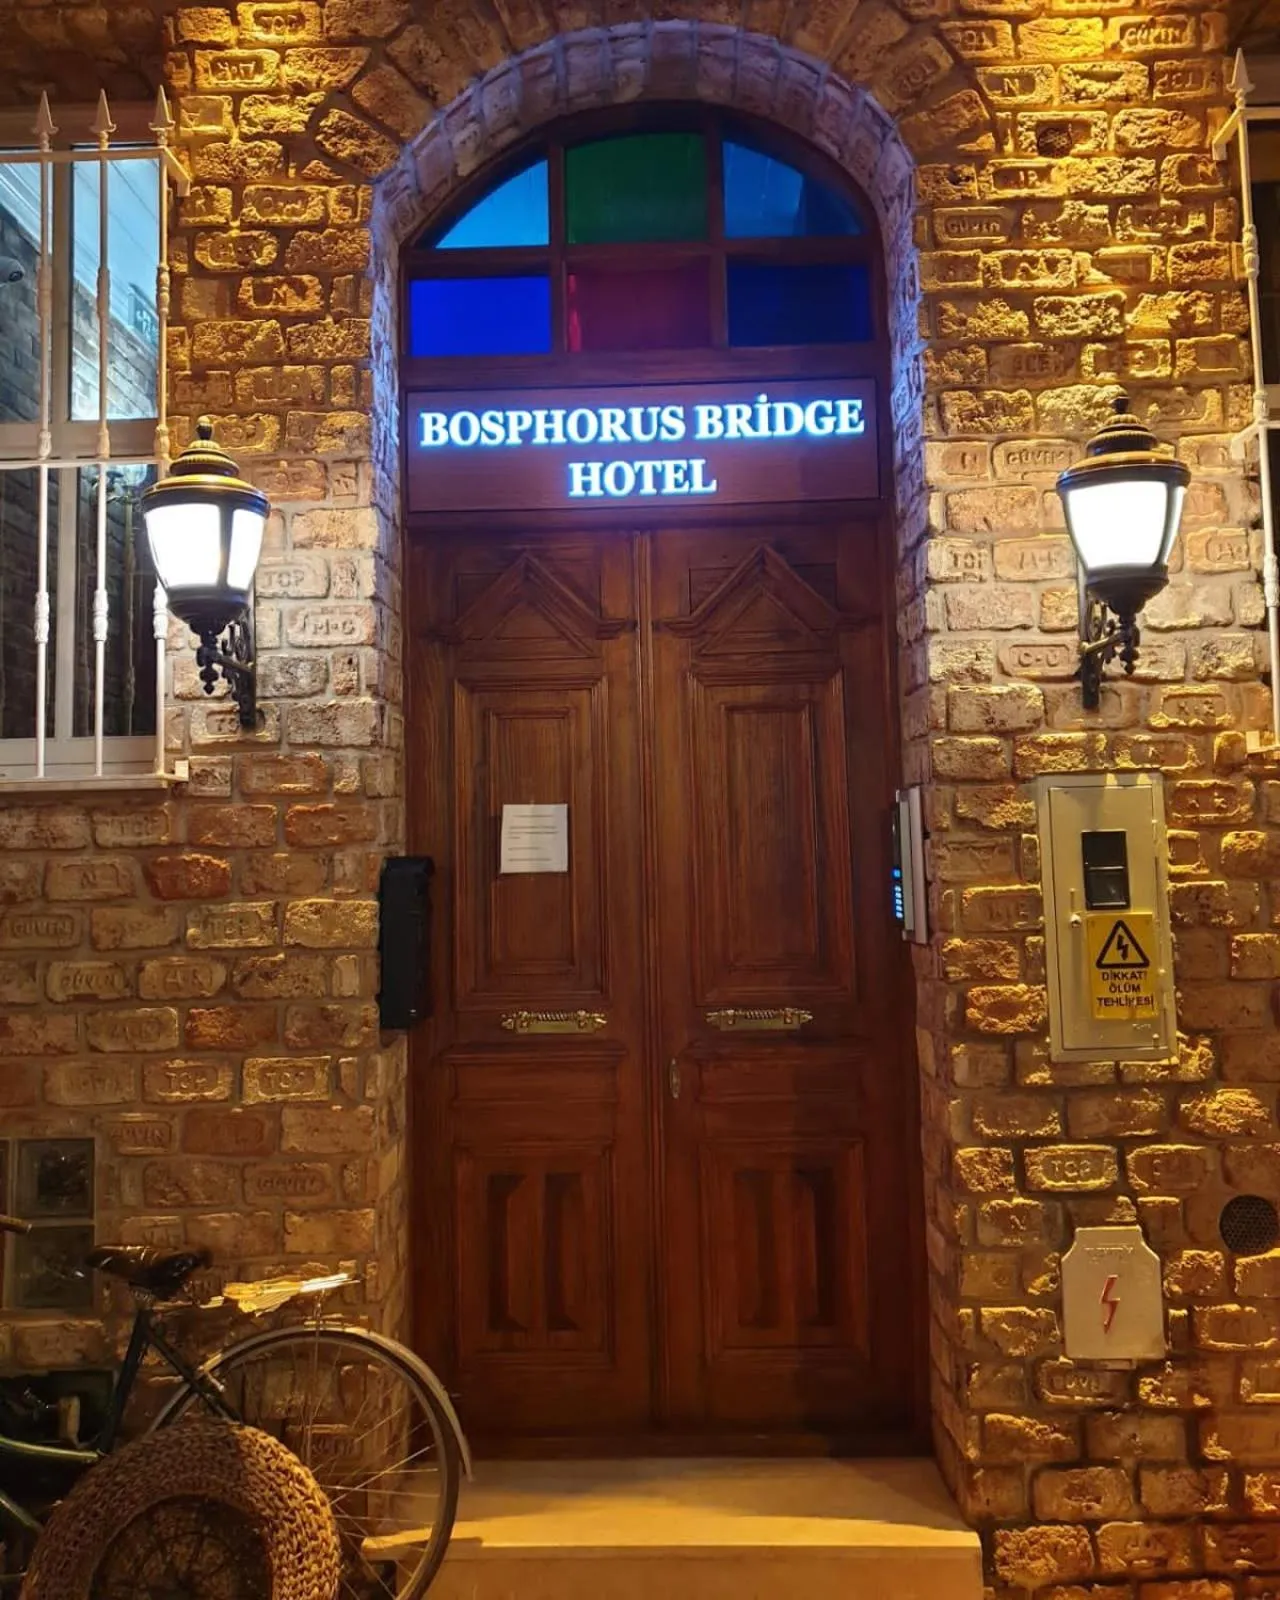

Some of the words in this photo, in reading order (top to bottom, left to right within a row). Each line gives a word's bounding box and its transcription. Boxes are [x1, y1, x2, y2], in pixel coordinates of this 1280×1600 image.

[419, 406, 686, 446] BOSPHORUS
[693, 394, 866, 441] BRİDGE
[568, 459, 717, 497] HOTEL
[1109, 982, 1141, 993] ÖLÜM
